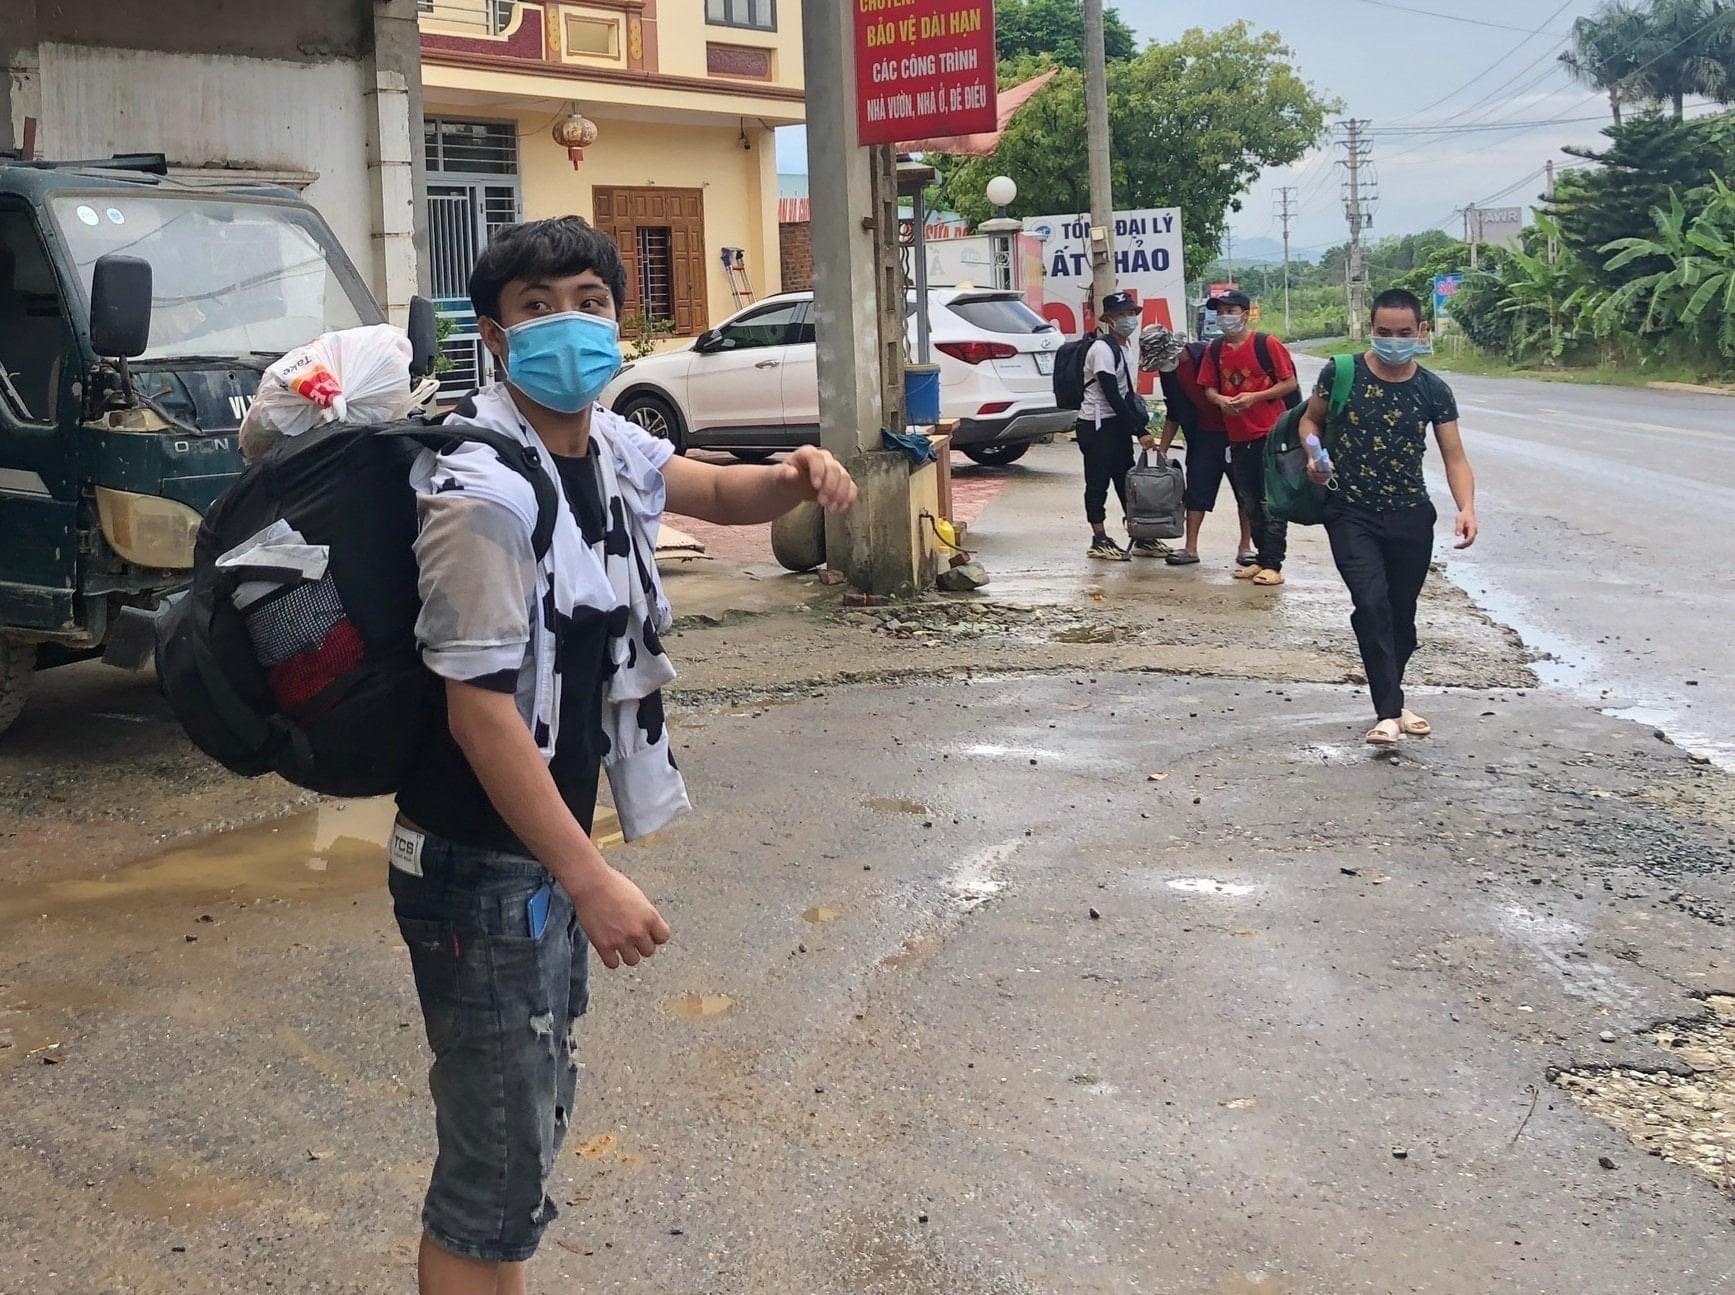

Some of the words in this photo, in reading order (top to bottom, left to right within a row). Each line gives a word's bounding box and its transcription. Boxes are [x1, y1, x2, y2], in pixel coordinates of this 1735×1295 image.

[867, 16, 895, 47] BẢO
[899, 14, 916, 46] VỆ
[921, 10, 945, 39] DÀI
[950, 8, 981, 38] HẠN
[873, 57, 897, 82] CÁC
[901, 53, 935, 79] CÔNG
[939, 47, 977, 73] TRÌNH
[867, 92, 886, 122] NHÀ
[917, 86, 937, 115] NHÀ
[1152, 212, 1174, 233] LÝ
[1115, 239, 1170, 273] HẢO
